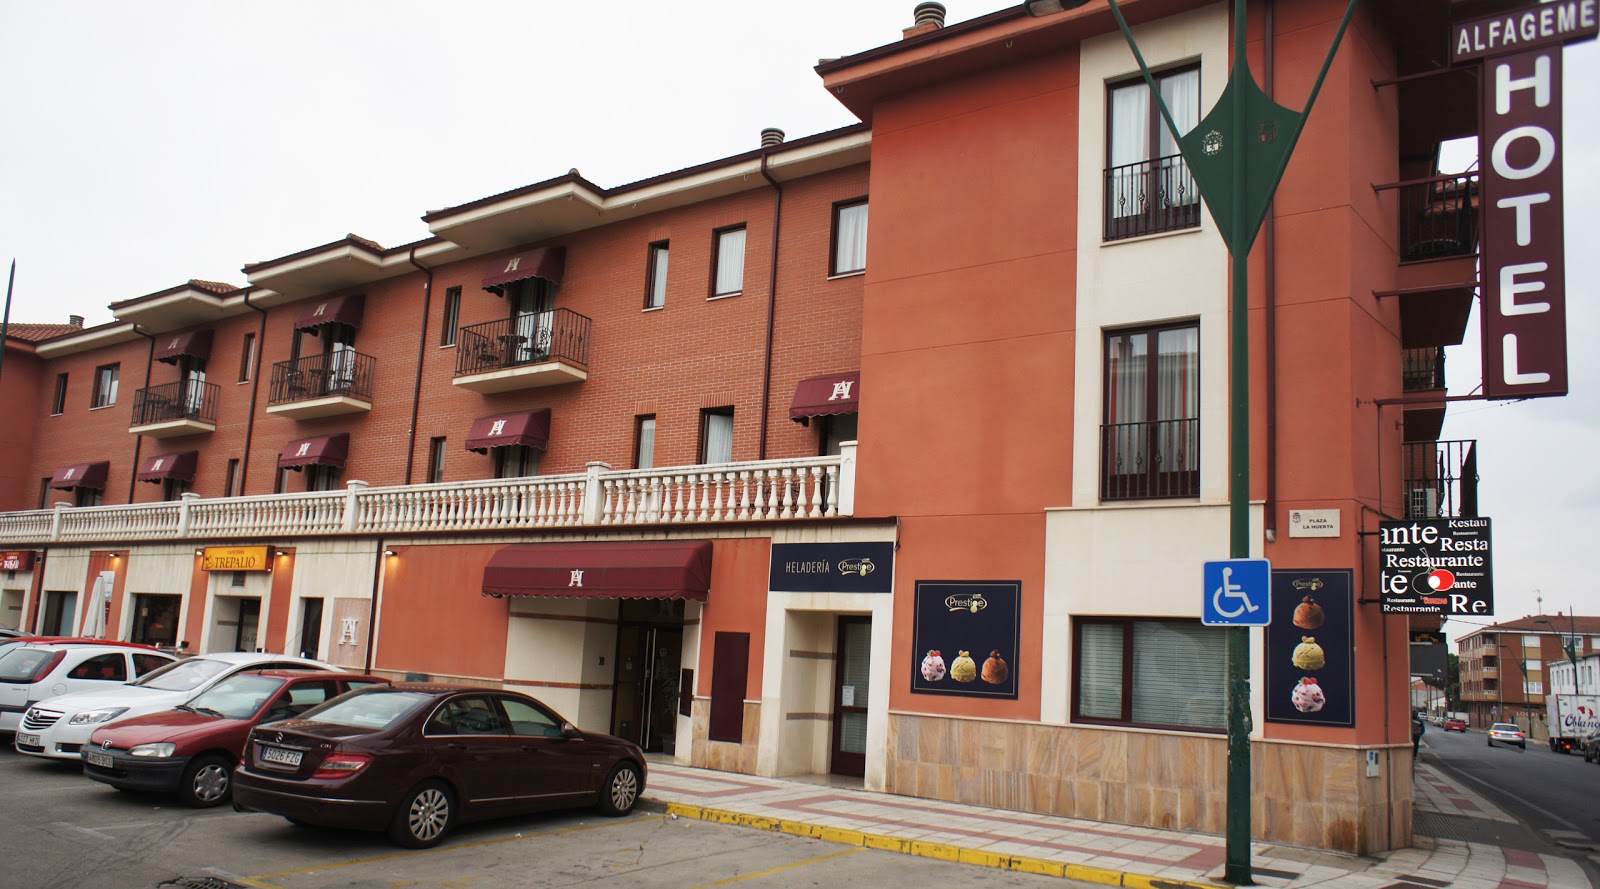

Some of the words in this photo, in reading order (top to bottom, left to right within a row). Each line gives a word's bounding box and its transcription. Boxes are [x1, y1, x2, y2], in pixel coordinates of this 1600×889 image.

[1457, 1, 1595, 55] ALFAGEME
[1491, 55, 1556, 386] HOTEL
[1440, 537, 1488, 551] Resta
[214, 556, 255, 568] TREPALIO
[785, 559, 830, 573] HELADERÍA
[1386, 554, 1483, 567] Restaurante
[267, 748, 285, 760] 5026
[286, 751, 300, 764] FZG
